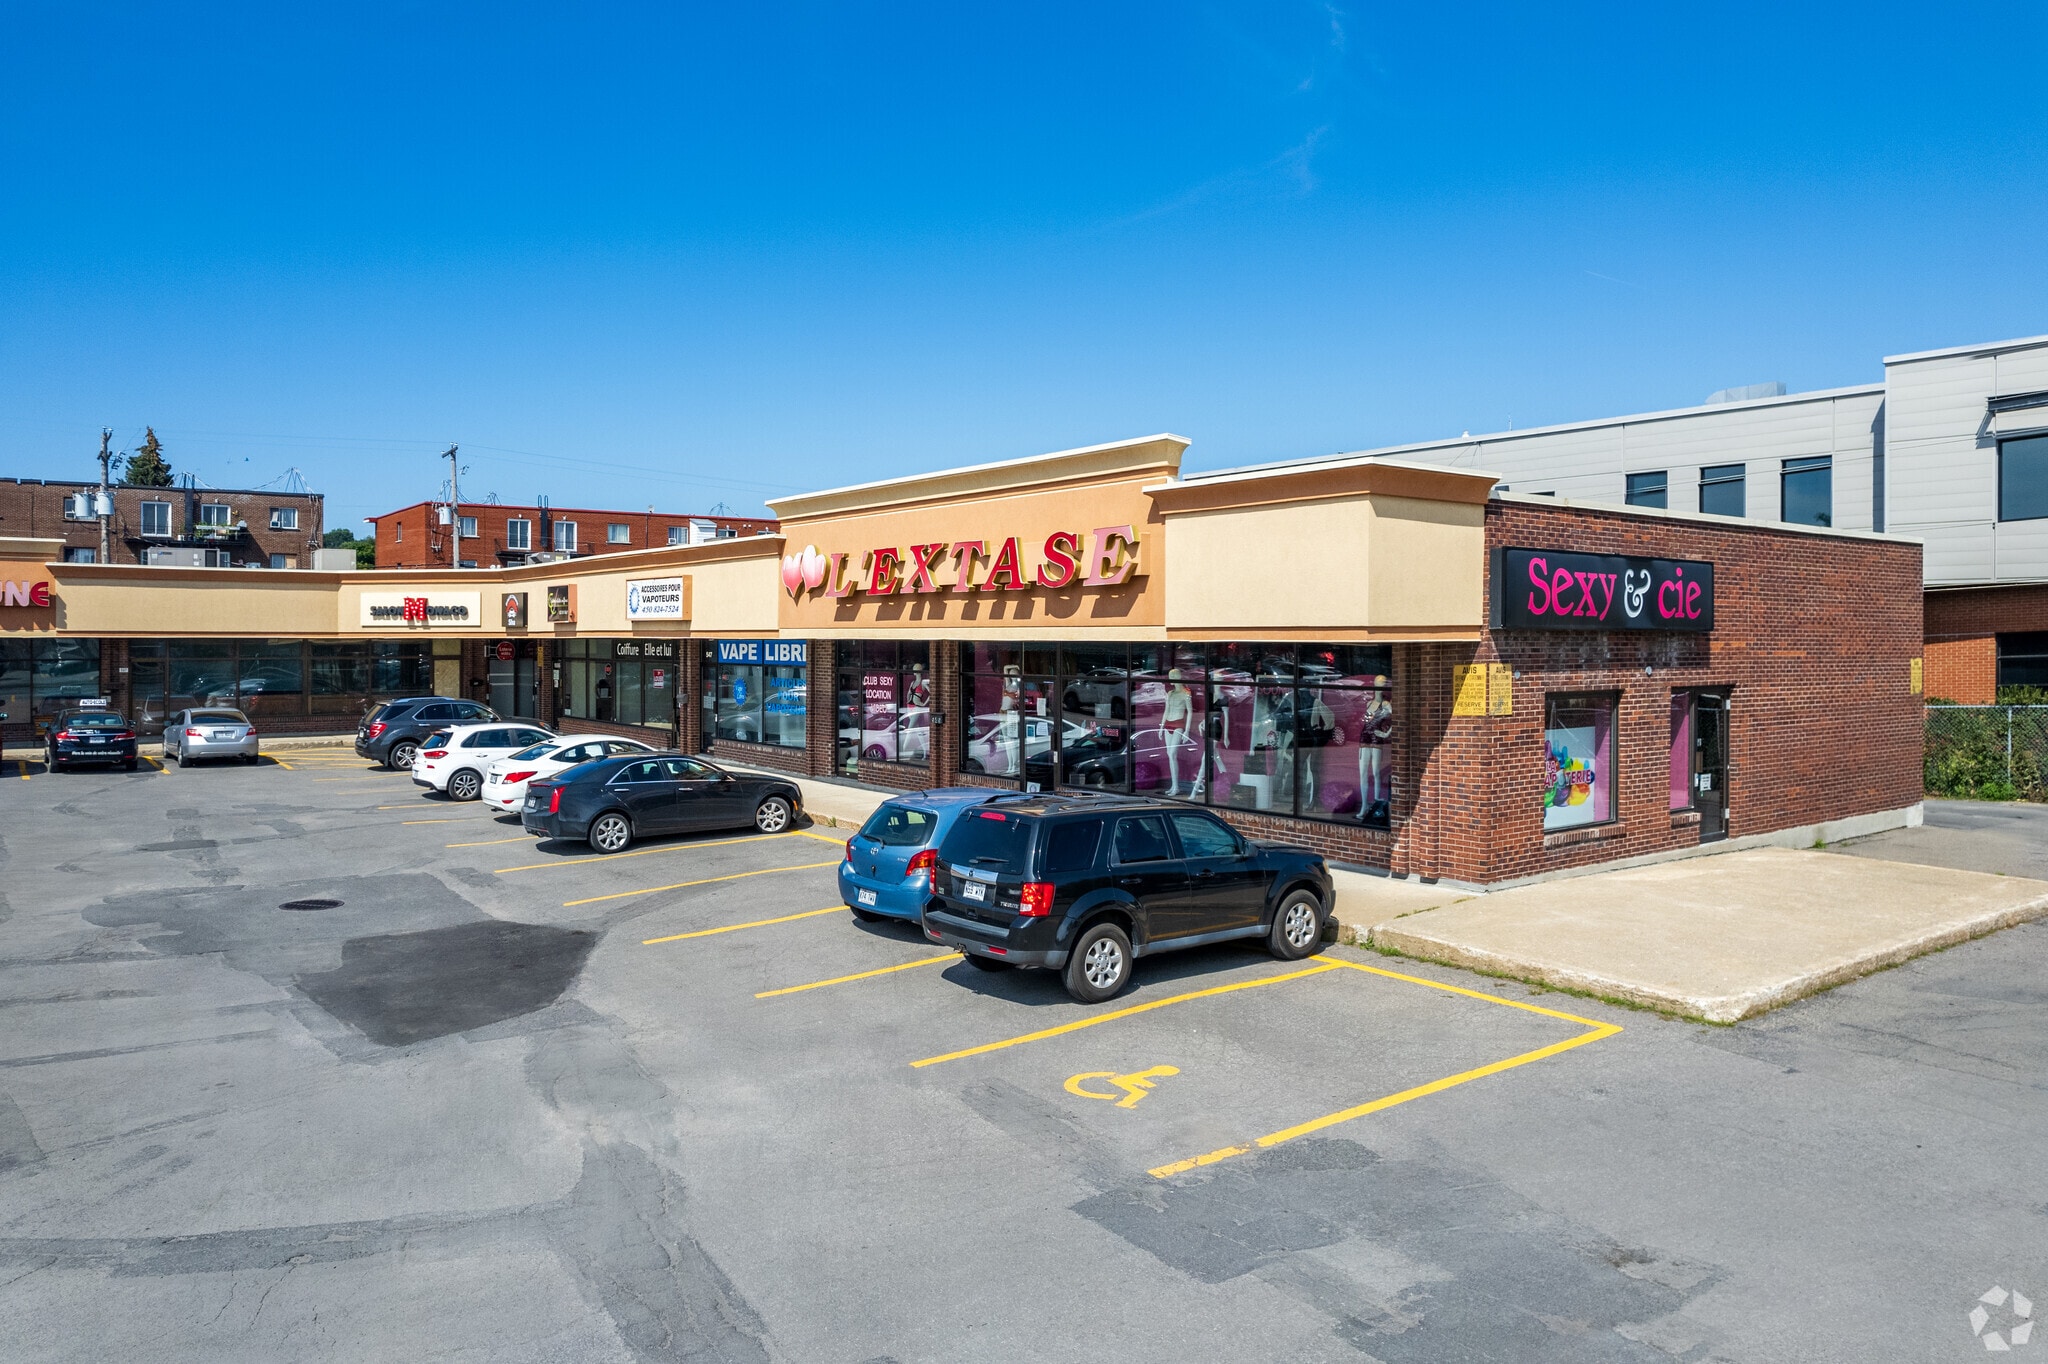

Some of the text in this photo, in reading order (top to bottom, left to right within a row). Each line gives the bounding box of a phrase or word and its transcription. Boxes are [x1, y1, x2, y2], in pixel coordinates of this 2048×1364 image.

[825, 525, 1138, 597] L'EXTASE
[641, 583, 681, 593] ACCESSOIRES POUR
[1527, 557, 1702, 621] Sexy & cie
[0, 580, 49, 607] NE
[642, 594, 680, 603] VAPOTEURS
[653, 605, 679, 613] 824-7524
[617, 643, 672, 656] Coiffure Elle et lui
[720, 643, 757, 660] VAPE
[1462, 666, 1477, 674] AVIS
[863, 676, 893, 686] CLUB SEXY
[777, 691, 799, 701] POUR
[865, 689, 892, 699] LOCATION
